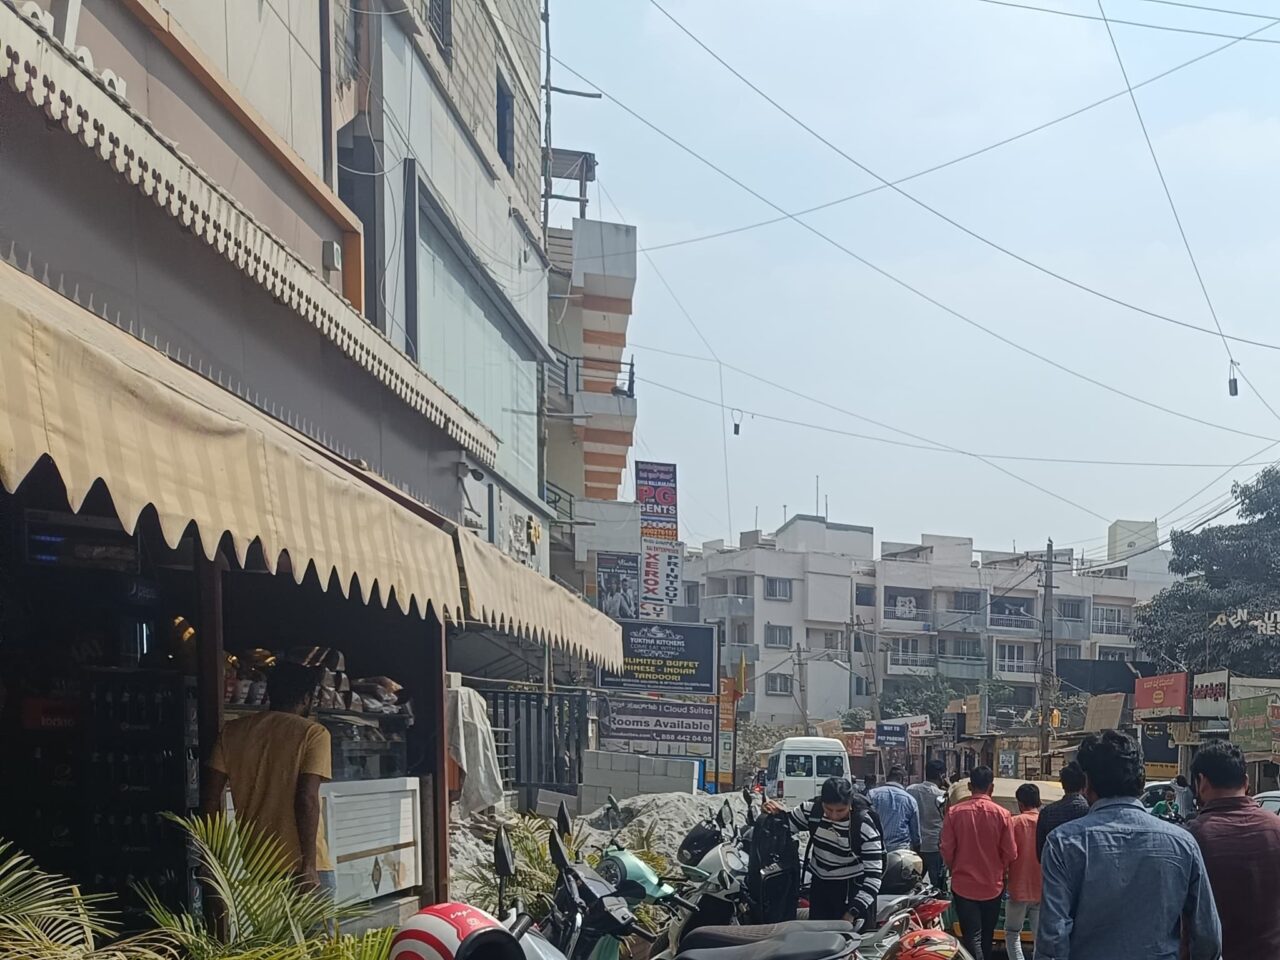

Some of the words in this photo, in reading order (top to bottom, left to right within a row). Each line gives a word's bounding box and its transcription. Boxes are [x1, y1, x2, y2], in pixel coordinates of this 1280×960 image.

[638, 486, 676, 506] PG
[639, 504, 676, 514] GENTS
[643, 552, 660, 595] XEROX
[665, 555, 679, 604] PRINTOUT
[630, 637, 655, 645] YUKTHA
[656, 638, 685, 647] KITCHENS
[666, 660, 700, 668] BUFFET
[624, 665, 656, 673] HINESE
[663, 667, 696, 675] INDIAN
[634, 672, 681, 681] TANDOORI
[663, 705, 688, 714] Cloud
[689, 706, 713, 715] Suites
[609, 716, 651, 728] Rooms
[654, 719, 710, 731] Available
